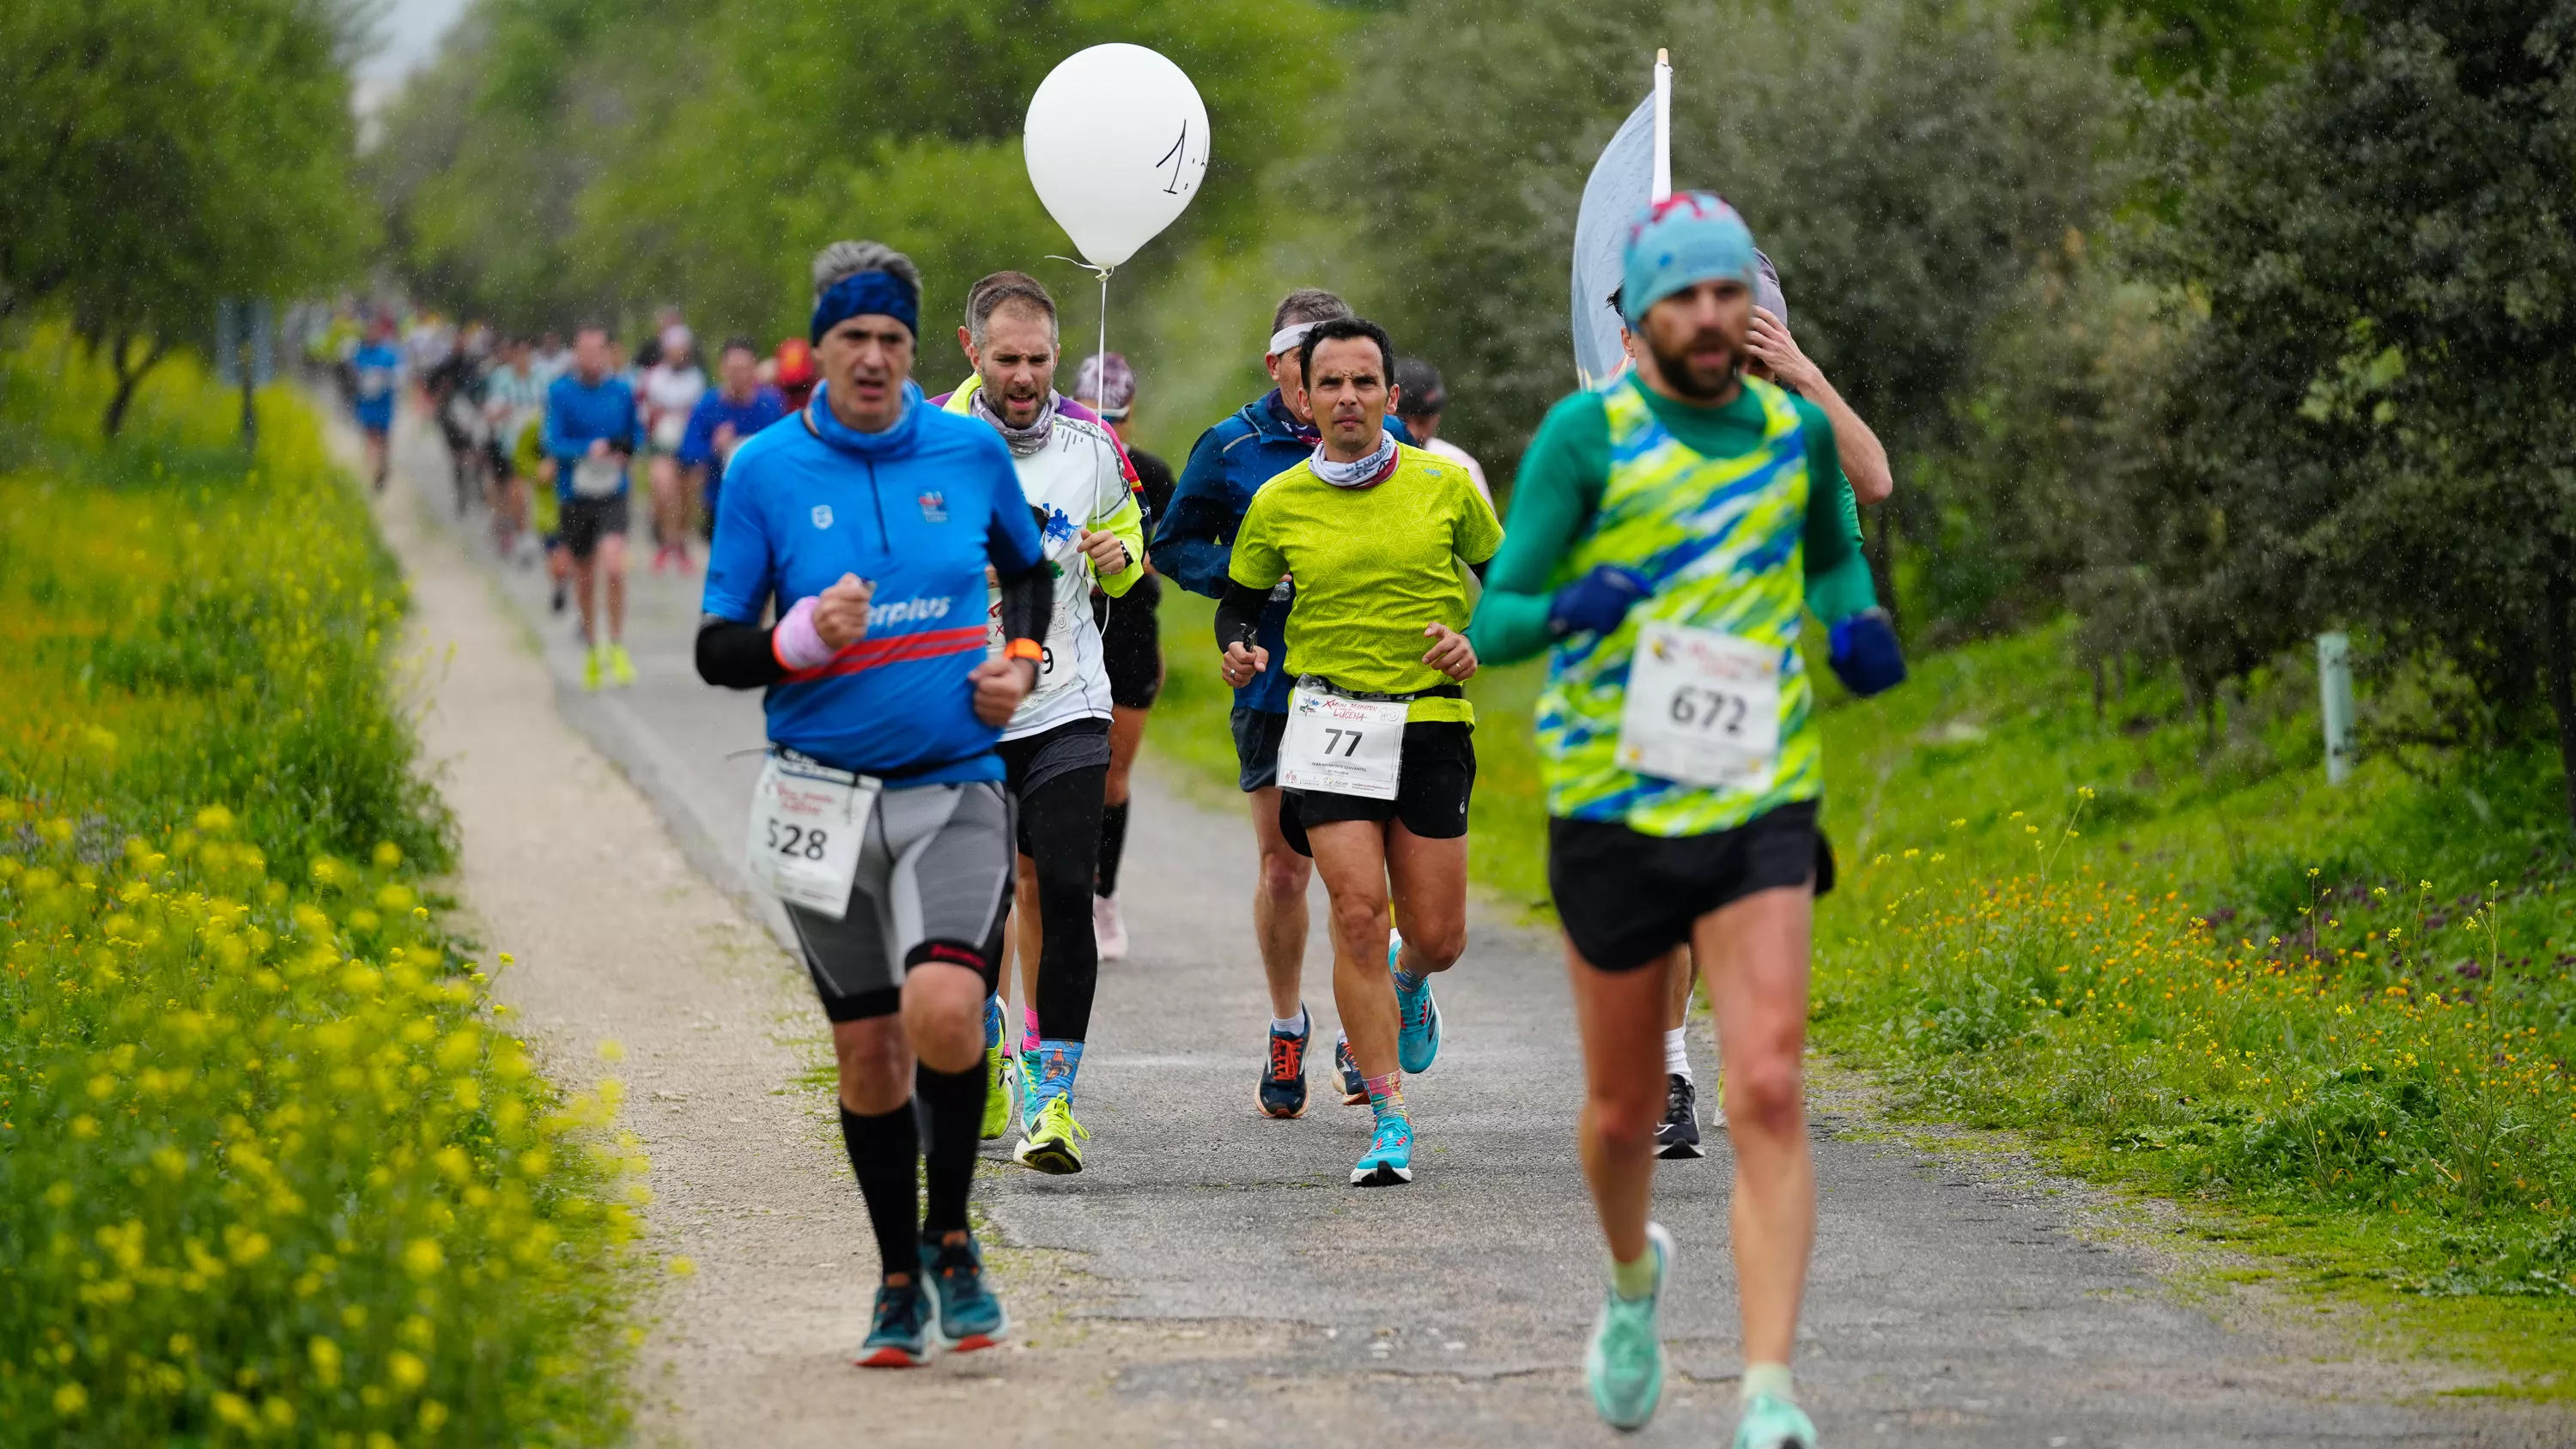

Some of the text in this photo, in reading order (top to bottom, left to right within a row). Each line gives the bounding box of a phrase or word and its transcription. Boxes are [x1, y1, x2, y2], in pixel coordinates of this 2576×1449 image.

[1334, 708, 1367, 721] LUCENA
[1669, 685, 1747, 735] 672
[1324, 728, 1363, 757] 77
